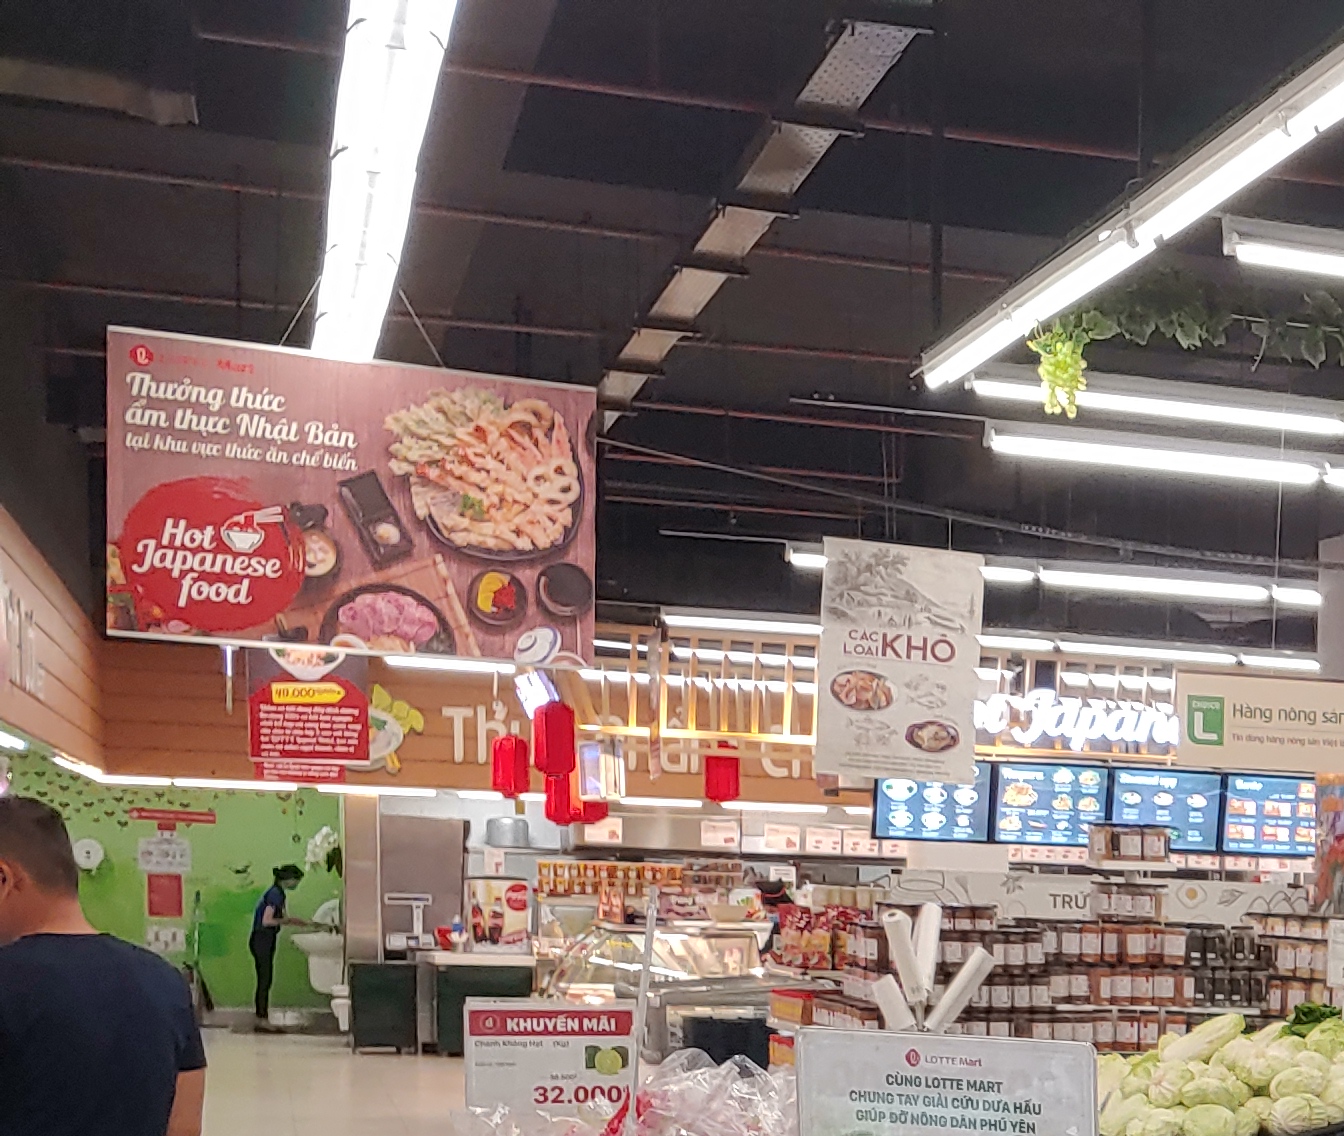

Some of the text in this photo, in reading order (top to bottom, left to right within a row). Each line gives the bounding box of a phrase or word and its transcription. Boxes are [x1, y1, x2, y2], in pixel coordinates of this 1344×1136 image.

[126, 371, 285, 412] Thưởng thức
[174, 409, 230, 437] thực
[236, 414, 299, 445] Nhật
[304, 421, 358, 449] Bản
[126, 432, 358, 472] tại khu vực thức ăn chế biến
[162, 518, 217, 550] Hot
[132, 539, 282, 579] Japanese
[177, 577, 252, 608] food
[1232, 703, 1272, 724] Hàng
[1277, 705, 1316, 725] nông
[505, 1015, 616, 1032] KHUYẾN MÃI
[925, 1056, 982, 1067] LOTTE Mart
[886, 1071, 1003, 1094] CÙNG LOTTE MART
[850, 1090, 1042, 1116] CHUNG TAY GIẢI CỨU DƯA HẤU
[855, 1107, 1036, 1135] GIÚP ĐỠ NÔNG DÂN PHÚ YÊN
